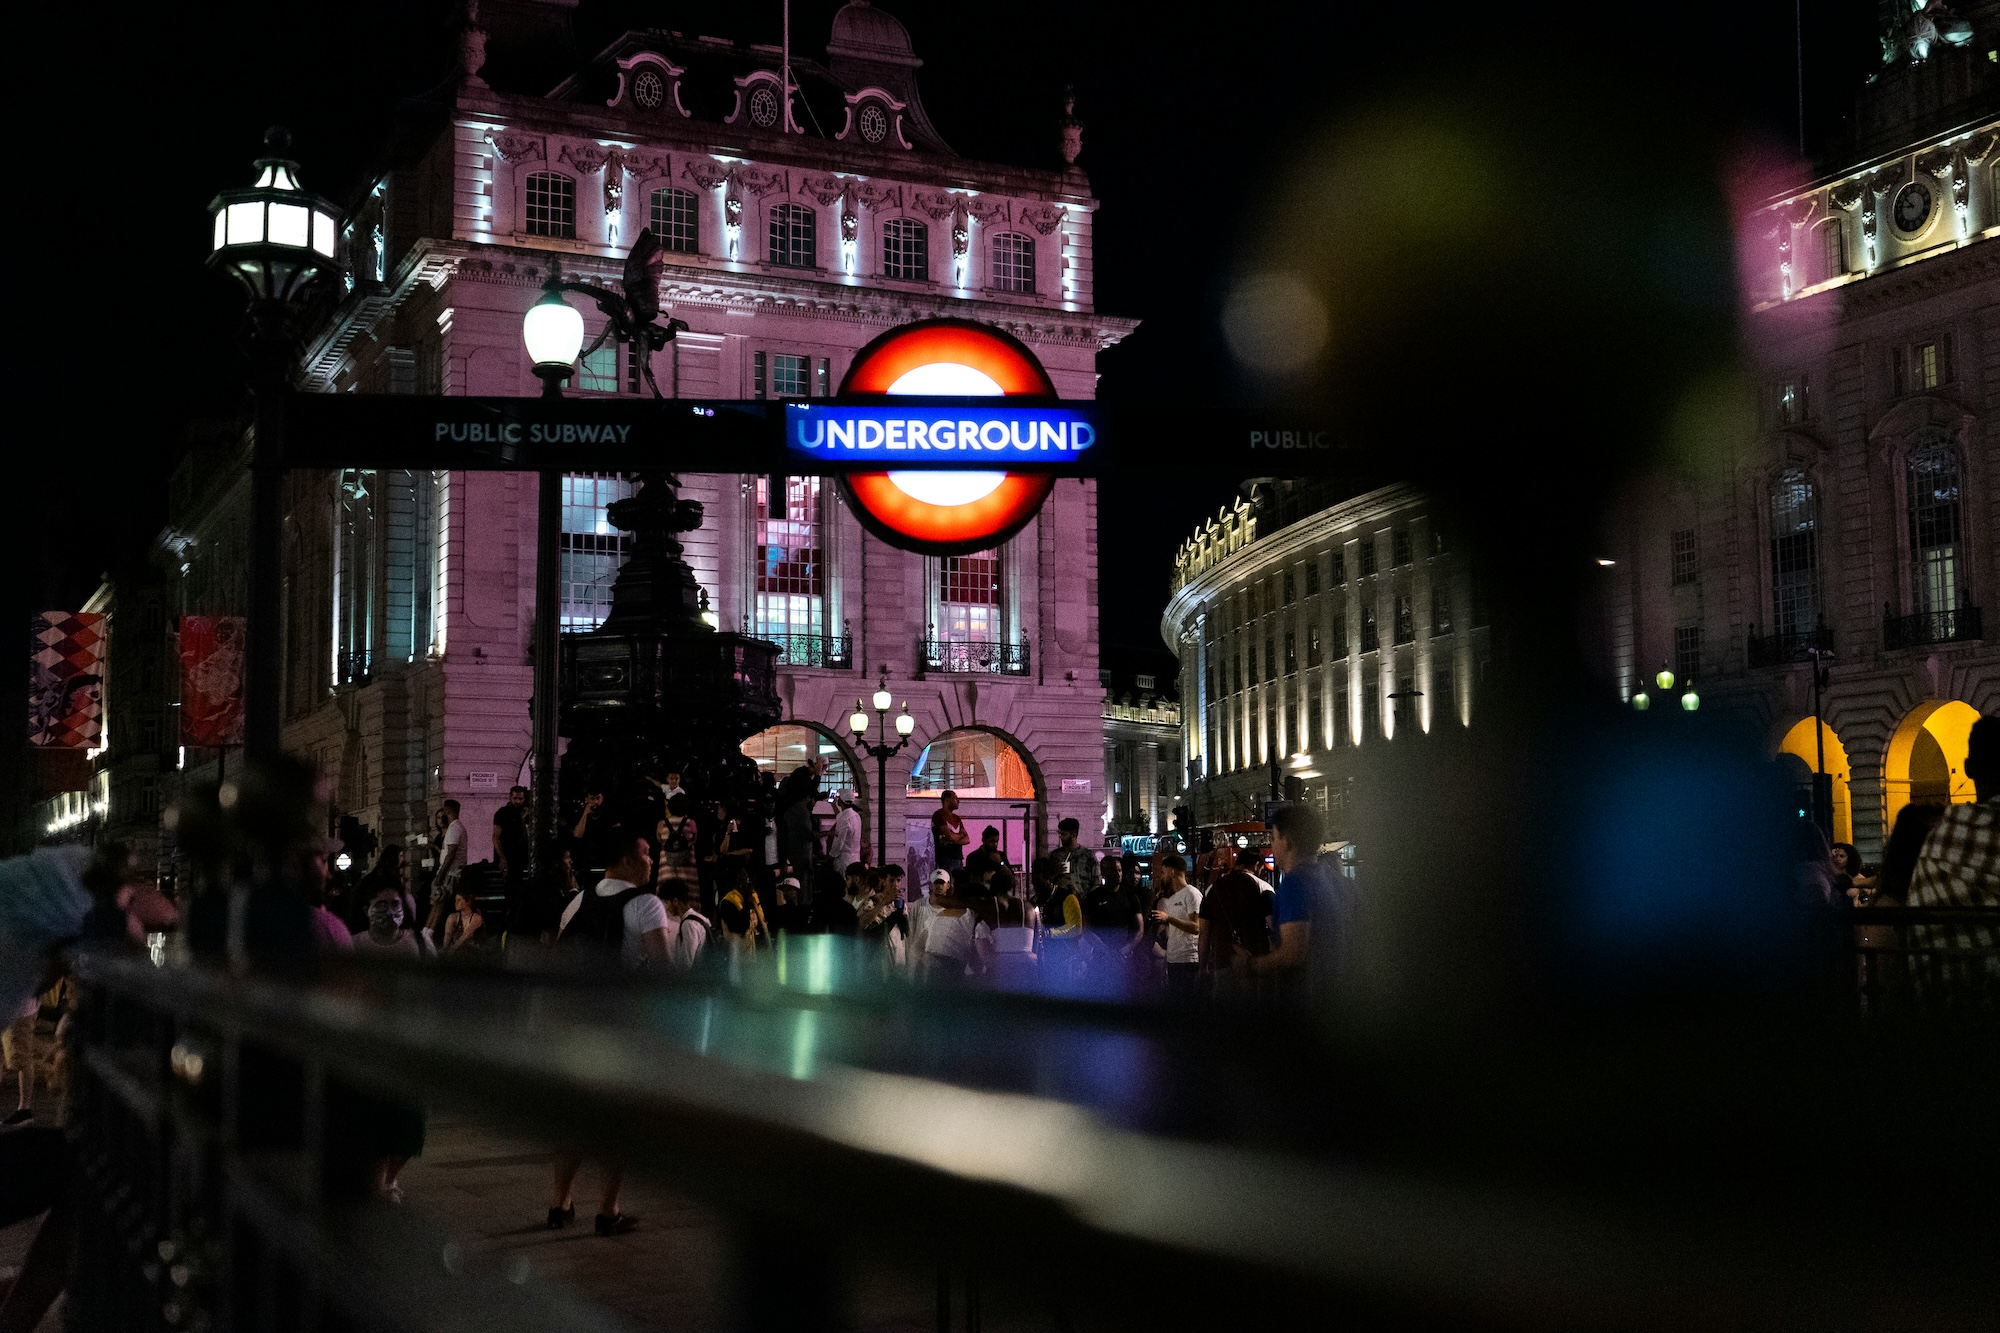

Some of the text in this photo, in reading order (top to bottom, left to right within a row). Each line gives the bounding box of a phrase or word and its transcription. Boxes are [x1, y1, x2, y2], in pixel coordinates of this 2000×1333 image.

[434, 422, 632, 444] PUBLIC SUBWAY
[797, 419, 1096, 451] UNDERGROUND
[1249, 430, 1330, 450] PUBLIC
